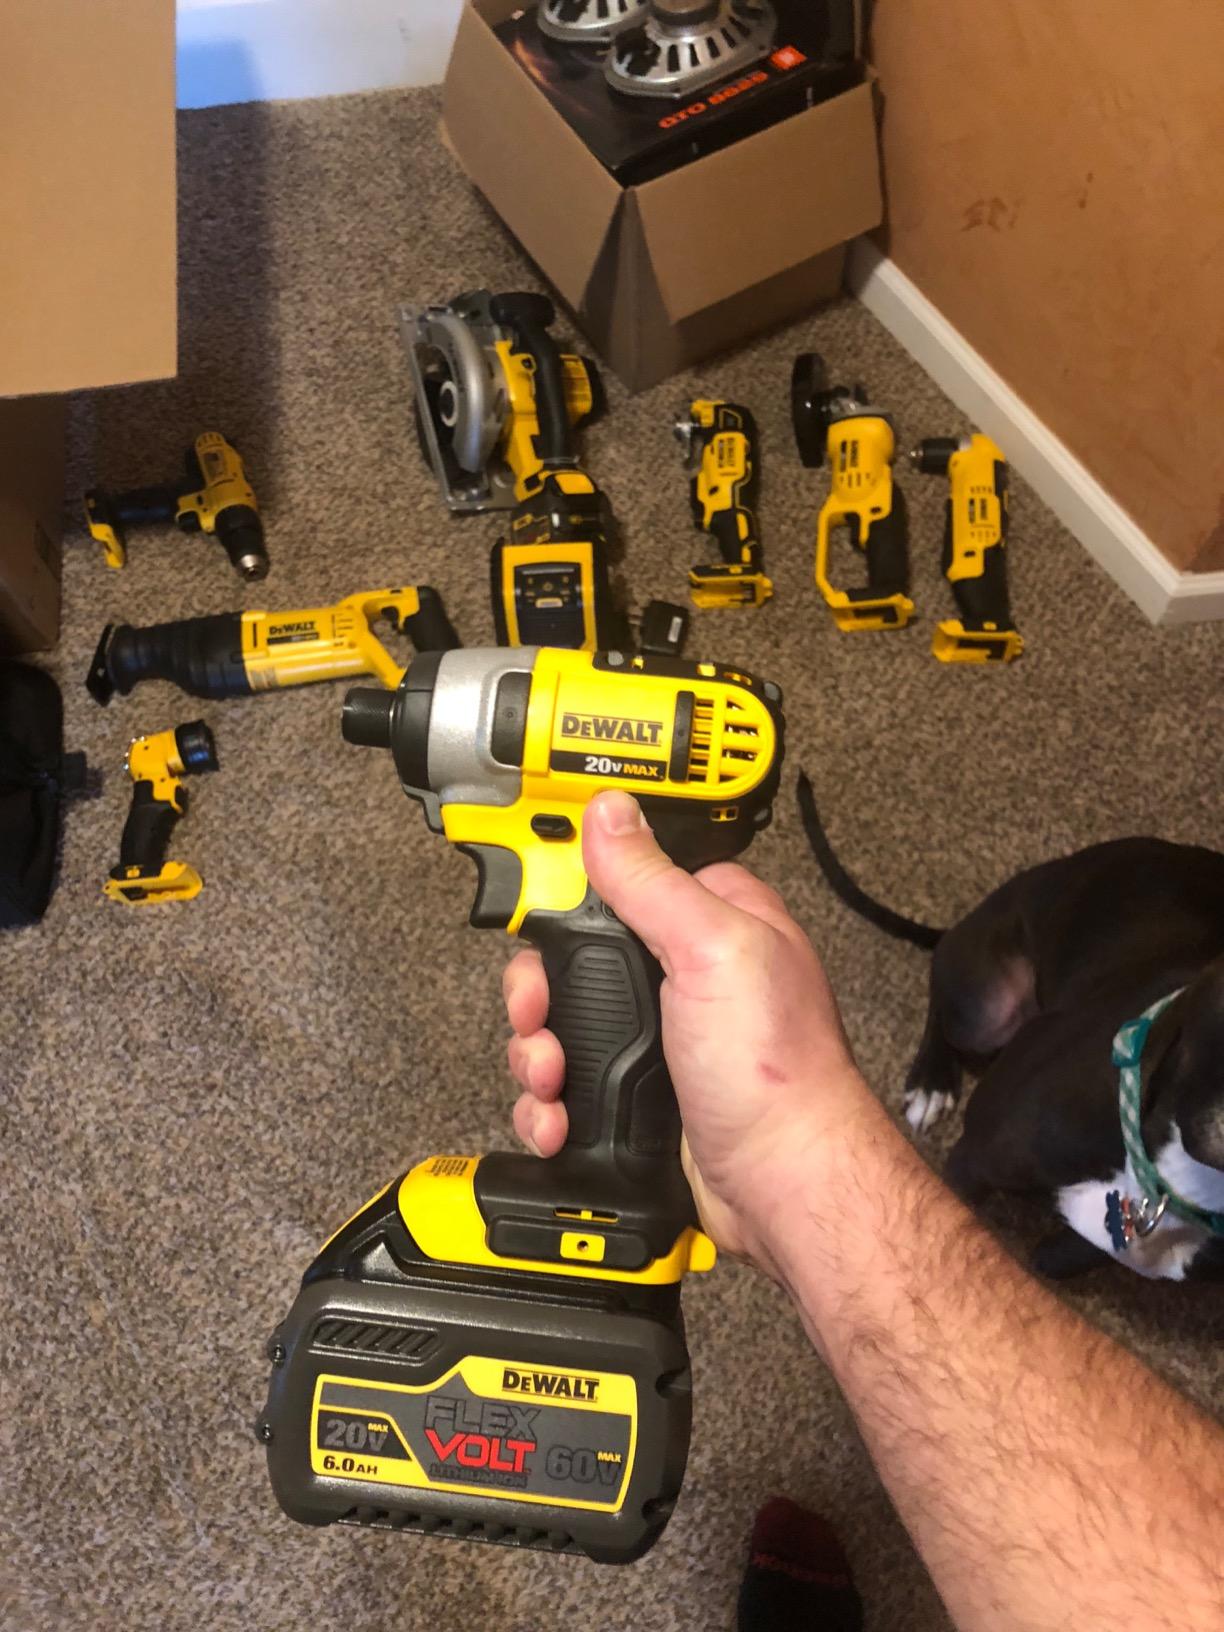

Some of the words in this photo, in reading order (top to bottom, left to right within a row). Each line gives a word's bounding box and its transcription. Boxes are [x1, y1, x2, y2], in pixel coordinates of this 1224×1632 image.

[623, 764, 659, 777] MAX
[323, 1418, 389, 1453] 20V
[368, 1422, 389, 1433] MAX
[423, 1395, 541, 1441] FLEX
[425, 1429, 536, 1474] VOLT
[545, 1444, 621, 1487] 60V
[597, 1451, 621, 1463] MAX
